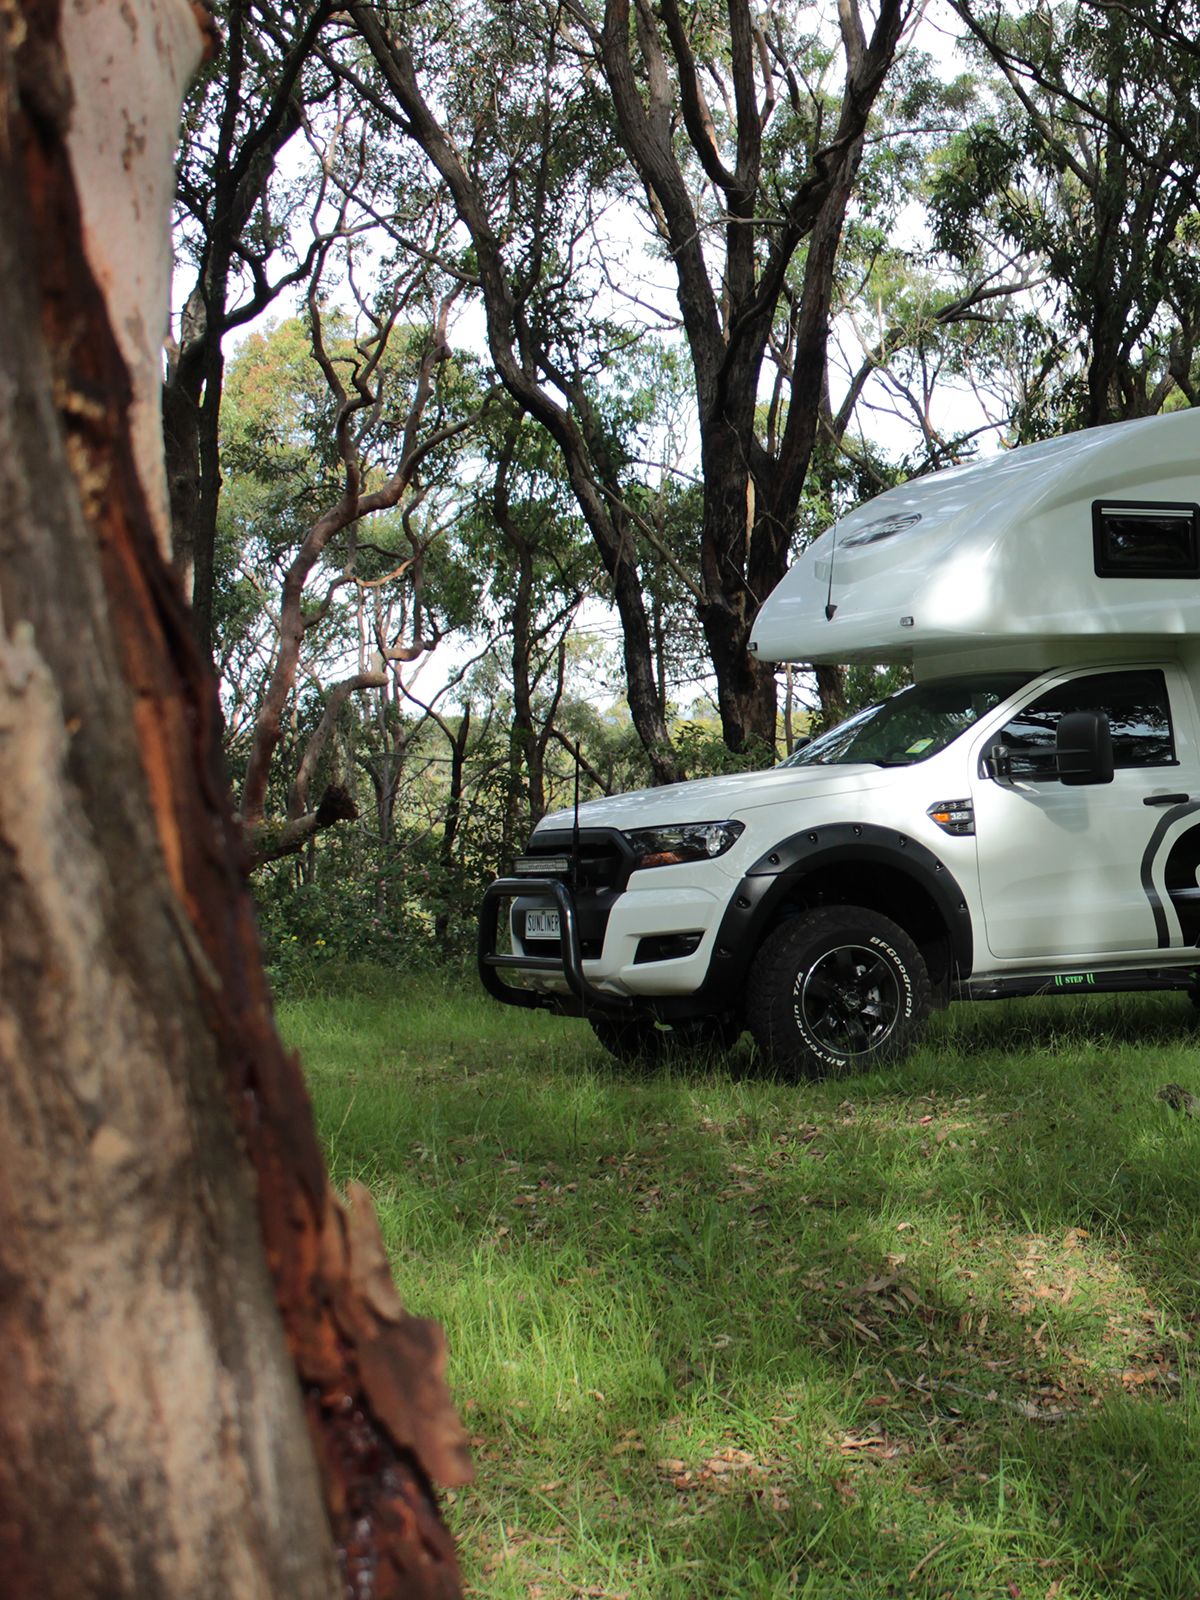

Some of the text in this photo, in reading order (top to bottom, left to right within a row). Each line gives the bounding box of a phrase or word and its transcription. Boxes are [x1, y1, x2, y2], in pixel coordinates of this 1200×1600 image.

[528, 914, 559, 932] SUNLINER
[793, 971, 804, 997] T/A
[869, 936, 914, 1018] BFGoodrich
[1065, 975, 1083, 983] STEP
